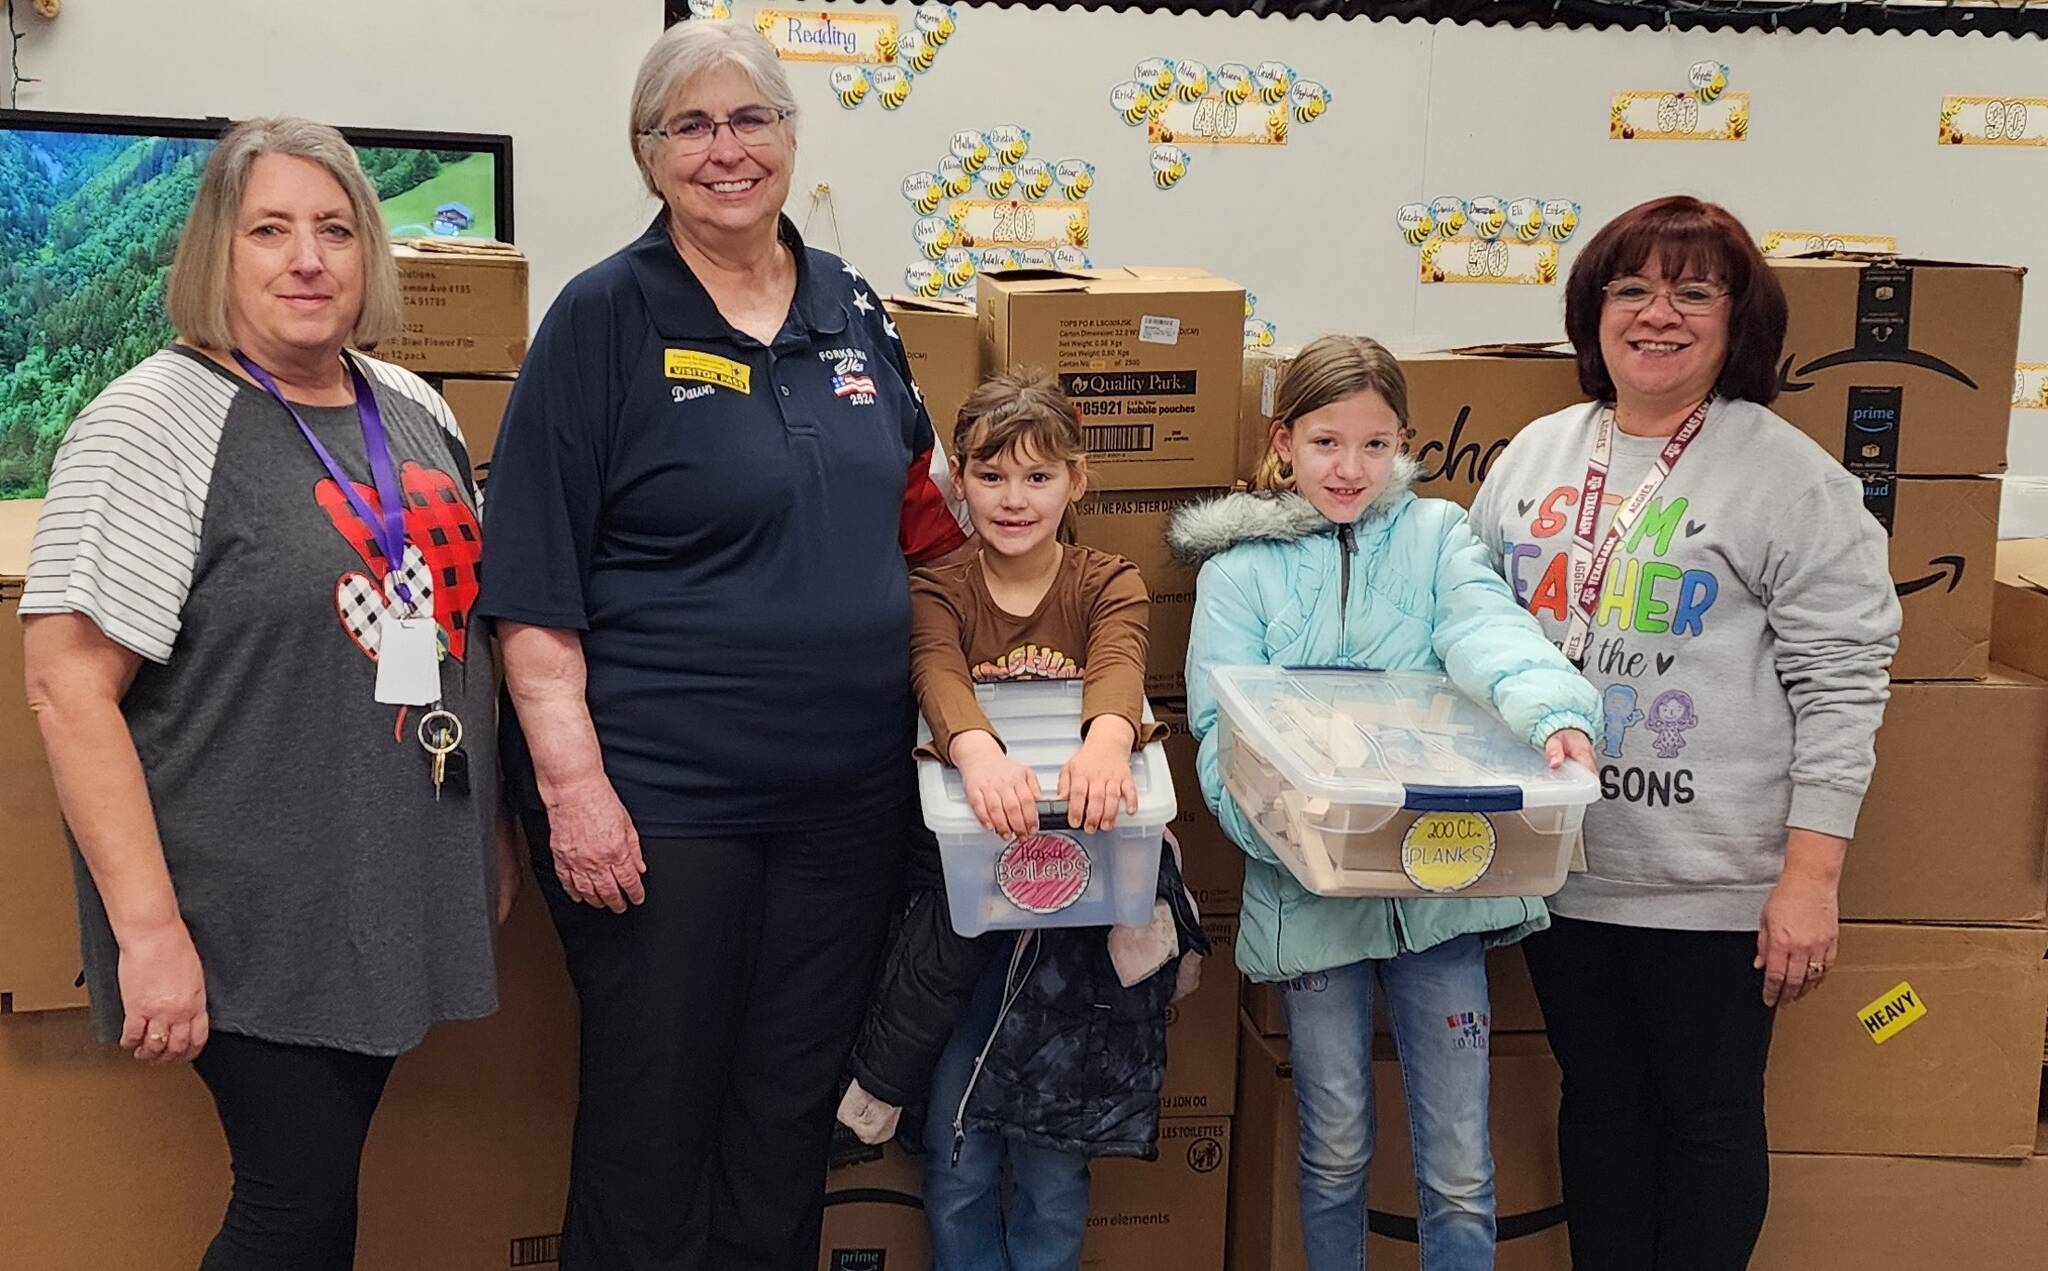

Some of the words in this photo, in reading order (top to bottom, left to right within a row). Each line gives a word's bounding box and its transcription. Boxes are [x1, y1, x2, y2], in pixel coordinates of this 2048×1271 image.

[787, 18, 856, 52] Reading
[1193, 97, 1237, 138] 40
[1984, 100, 2027, 140] 90
[993, 204, 1036, 243] 20
[1467, 239, 1508, 277] 50
[672, 366, 717, 382] VISITOR
[720, 374, 745, 390] PASS
[1090, 374, 1145, 393] Quality
[671, 384, 715, 403] Dawn
[1126, 404, 1157, 414] bubble
[1159, 405, 1196, 416] pouches
[1853, 406, 1895, 421] prime
[1678, 418, 1701, 443] TEXAS
[1101, 502, 1116, 516] NE
[1116, 502, 1133, 515] PAS
[1133, 501, 1160, 515] JETER
[1590, 556, 1605, 587] TEXAS
[1503, 541, 1719, 637] EAHER
[1598, 637, 1648, 678] the
[1599, 764, 1695, 808] SONS
[1427, 821, 1455, 839] 200
[1020, 844, 1063, 862] Hard
[1409, 844, 1486, 865] PLANKS
[1863, 990, 1917, 1034] HEAVY
[1172, 1096, 1192, 1108] NOT
[1193, 1096, 1207, 1107] DO
[1162, 1127, 1179, 1139] LES
[1179, 1126, 1224, 1138] TOILETTES
[1110, 1212, 1171, 1226] elements
[841, 1252, 879, 1266] prime
